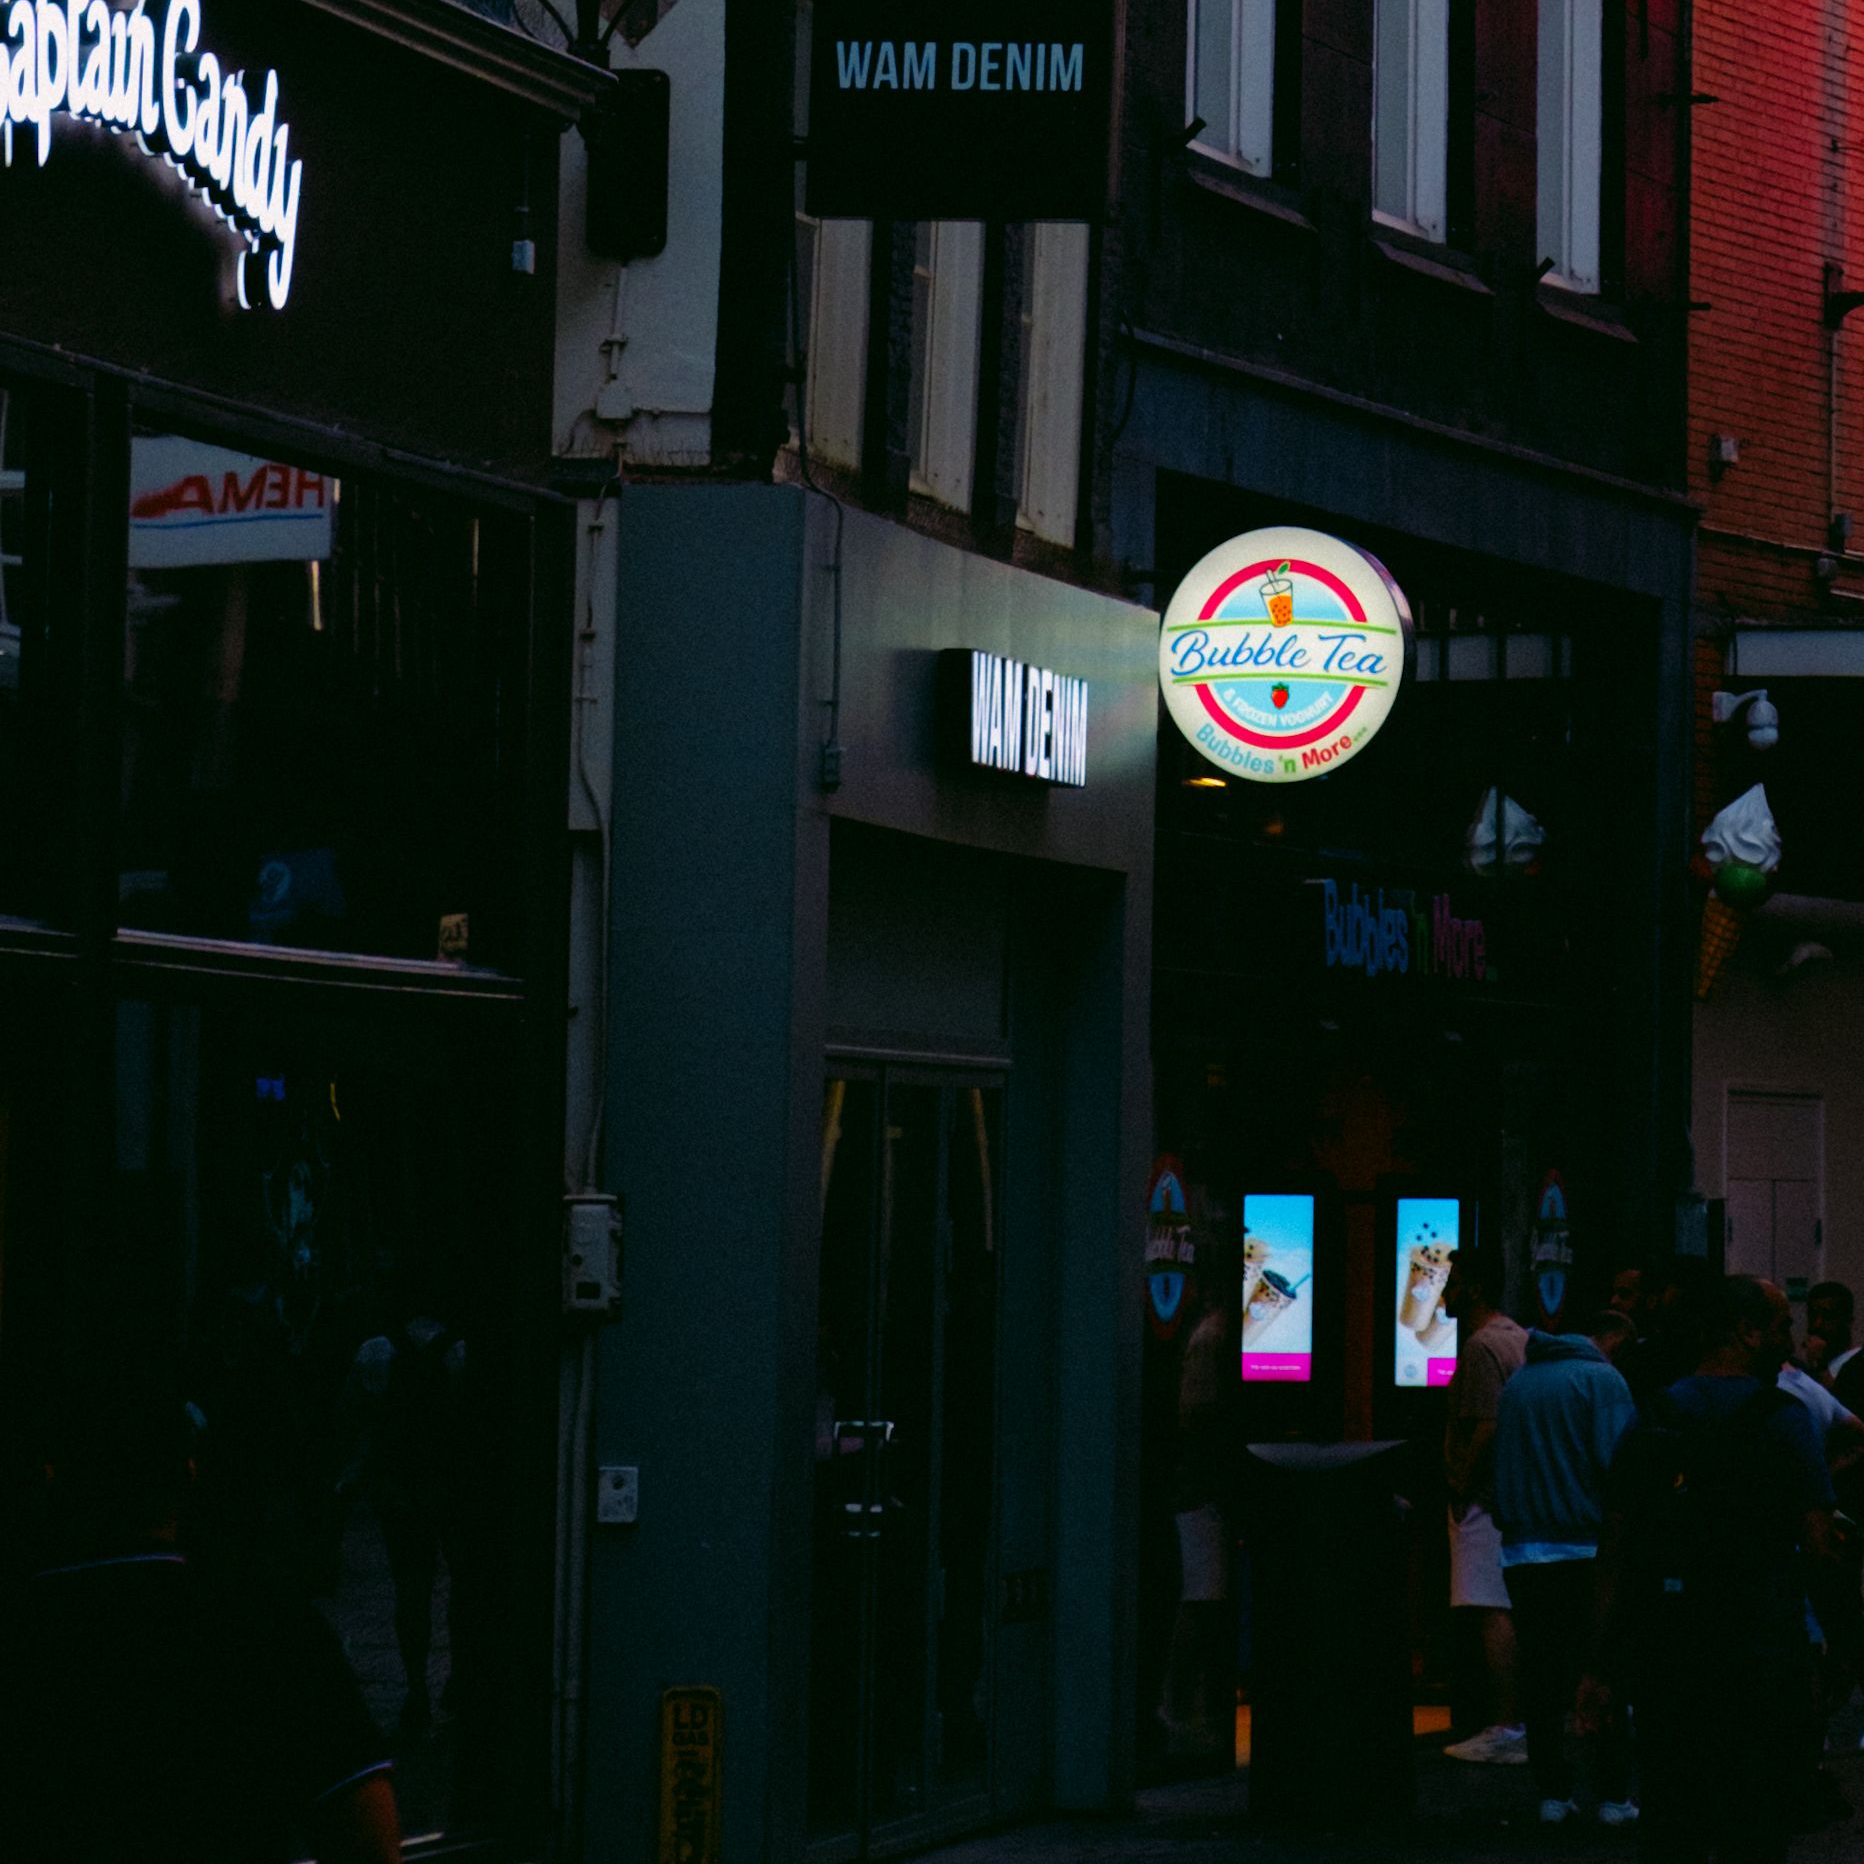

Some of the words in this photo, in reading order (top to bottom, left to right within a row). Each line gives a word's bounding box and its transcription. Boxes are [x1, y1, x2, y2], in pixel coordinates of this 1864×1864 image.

[835, 40, 938, 91] WAM
[950, 41, 1086, 93] DENIM
[1170, 629, 1312, 677] Bubble
[1318, 633, 1388, 675] Tea
[972, 649, 1023, 773] WAM
[1025, 665, 1089, 788] DENIM
[1233, 695, 1278, 728] FROZEN
[1195, 722, 1276, 775] Bubbles
[1323, 877, 1410, 978] Bubbles
